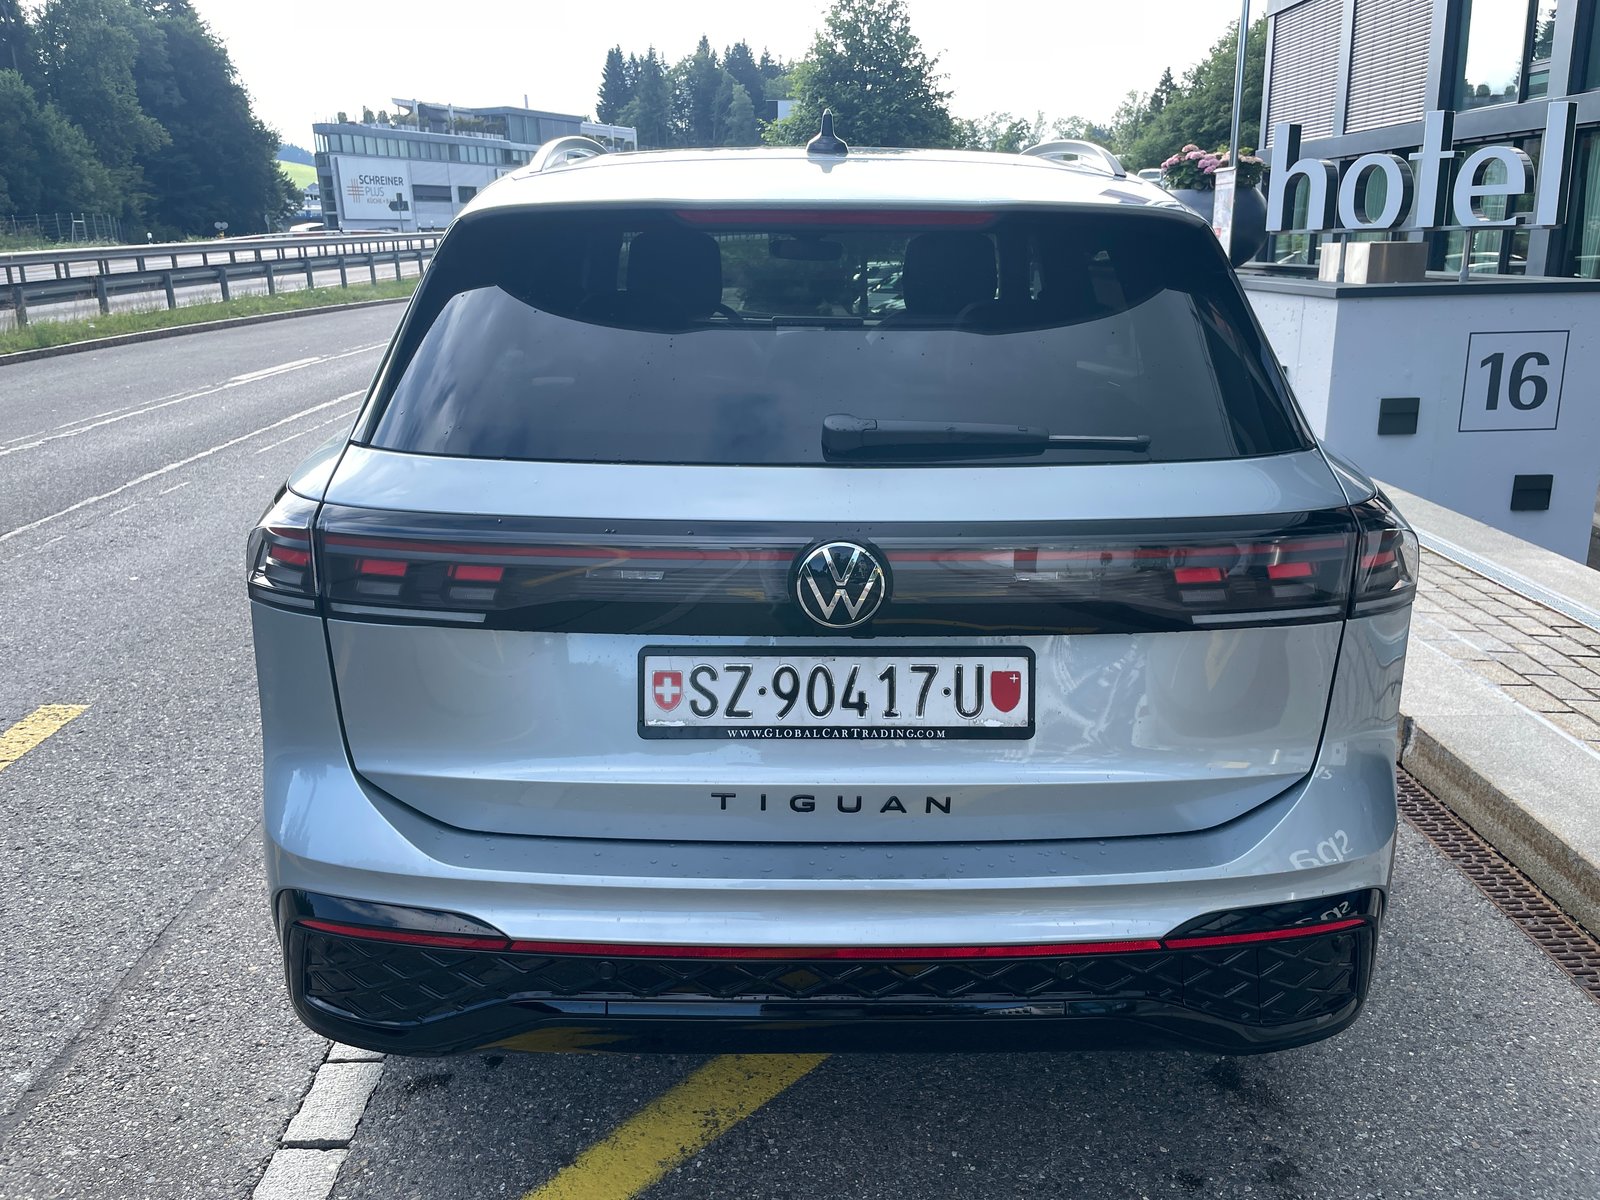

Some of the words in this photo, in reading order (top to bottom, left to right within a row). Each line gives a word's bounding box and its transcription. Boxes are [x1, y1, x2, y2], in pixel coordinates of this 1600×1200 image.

[359, 175, 404, 186] SCHREINER
[1265, 102, 1577, 231] hotel
[365, 187, 384, 197] PLUS
[1480, 352, 1550, 411] 16
[802, 545, 880, 621] VW
[711, 792, 951, 813] TIGUAN
